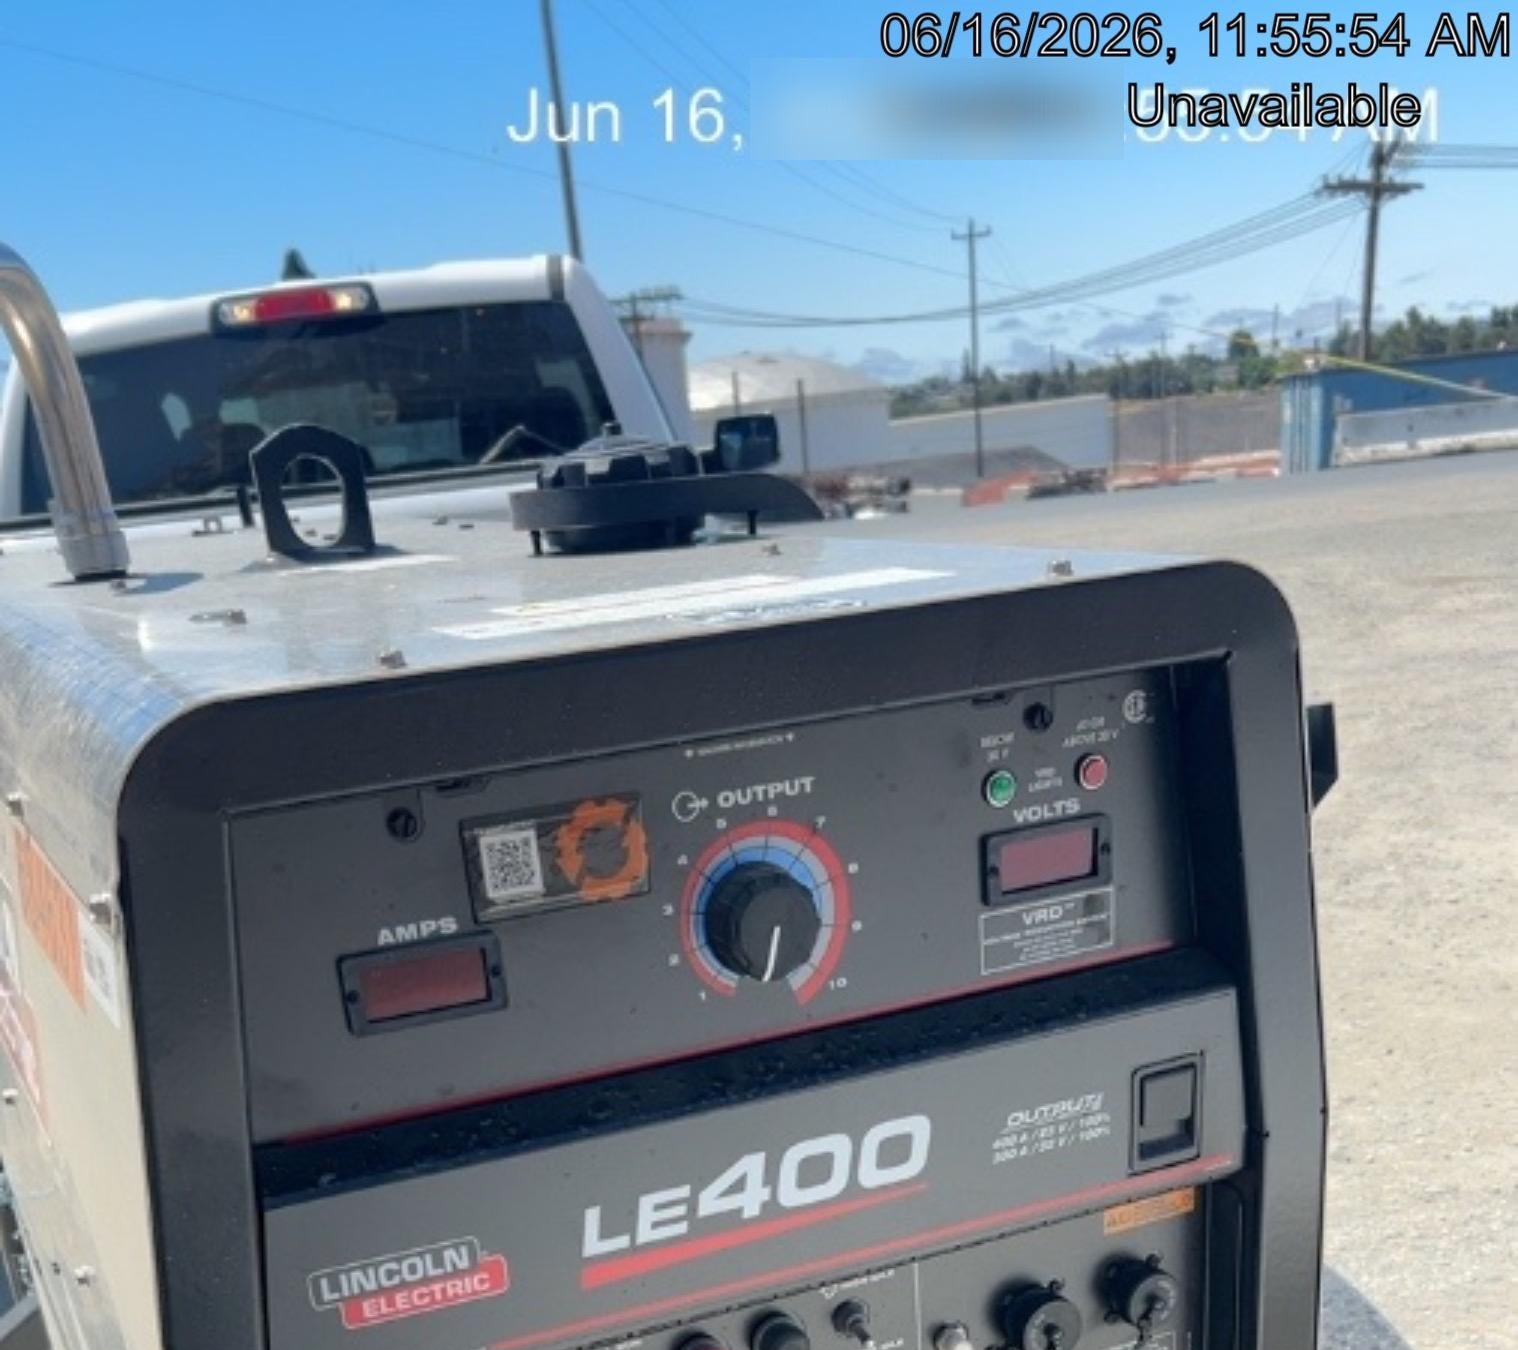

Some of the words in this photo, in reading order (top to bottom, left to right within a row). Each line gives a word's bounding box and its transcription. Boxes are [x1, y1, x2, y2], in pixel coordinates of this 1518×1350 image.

[717, 776, 815, 808] OUTPUT
[1013, 798, 1080, 823] VOLTS
[377, 916, 458, 946] AMPS
[582, 1114, 931, 1258] LE400
[319, 1245, 470, 1302] LINCOLN
[362, 1272, 491, 1319] ELECTRIC
